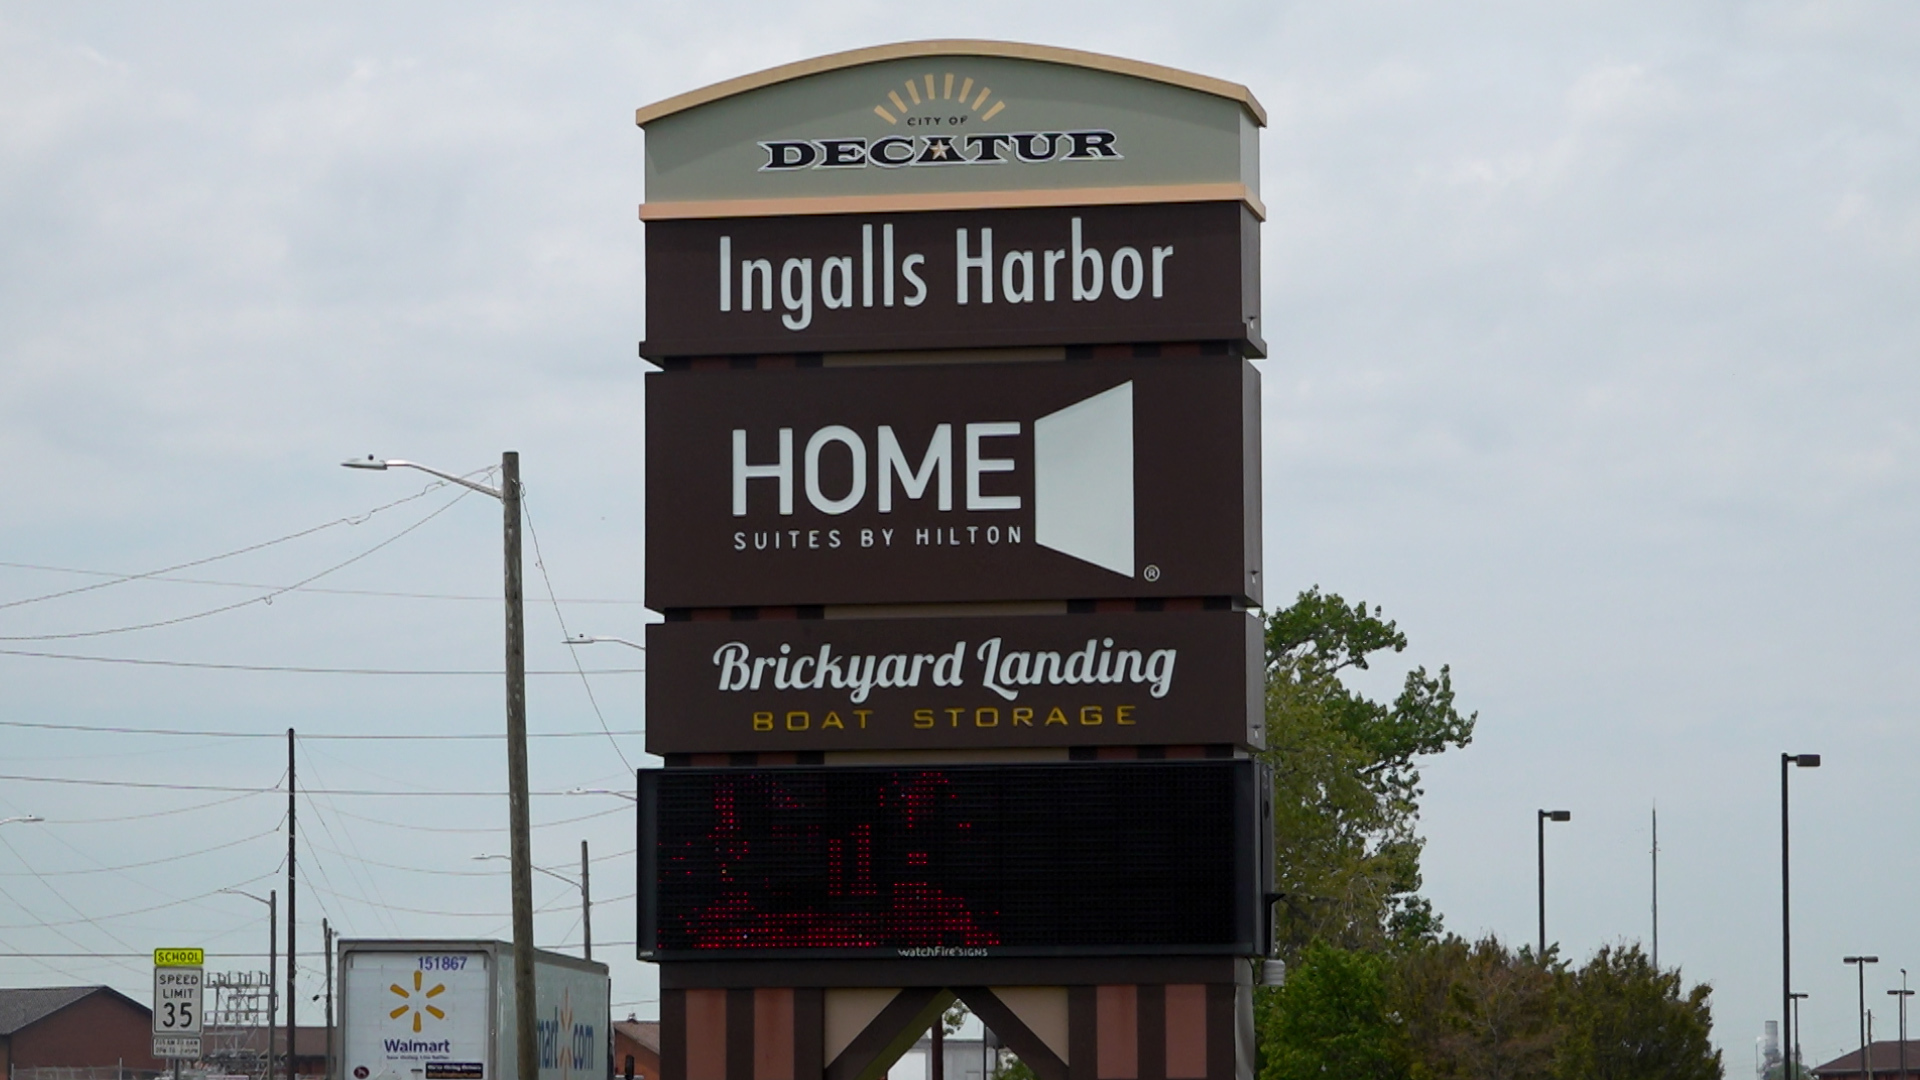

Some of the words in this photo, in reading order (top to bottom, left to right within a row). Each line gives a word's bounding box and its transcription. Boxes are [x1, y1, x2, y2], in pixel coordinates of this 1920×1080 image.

[907, 116, 944, 126] CITY
[948, 115, 968, 126] OF
[760, 129, 1124, 172] DECATUR
[719, 223, 928, 331] Ingalls
[956, 217, 1174, 306] Harbor
[732, 421, 1022, 516] HOME
[734, 529, 842, 550] SUITES
[861, 527, 895, 548] BY
[916, 525, 1022, 546] HILTON
[713, 640, 967, 704] Brickyard
[976, 637, 1177, 702] Landing
[753, 709, 875, 731] BOAT
[914, 704, 1137, 728] STORAGE
[158, 952, 199, 962] SCHOOL
[418, 956, 467, 971] 151867
[159, 974, 199, 985] SPEED
[163, 988, 194, 999] LIMIT
[162, 1002, 192, 1028] 35
[384, 1039, 450, 1053] Walmart
